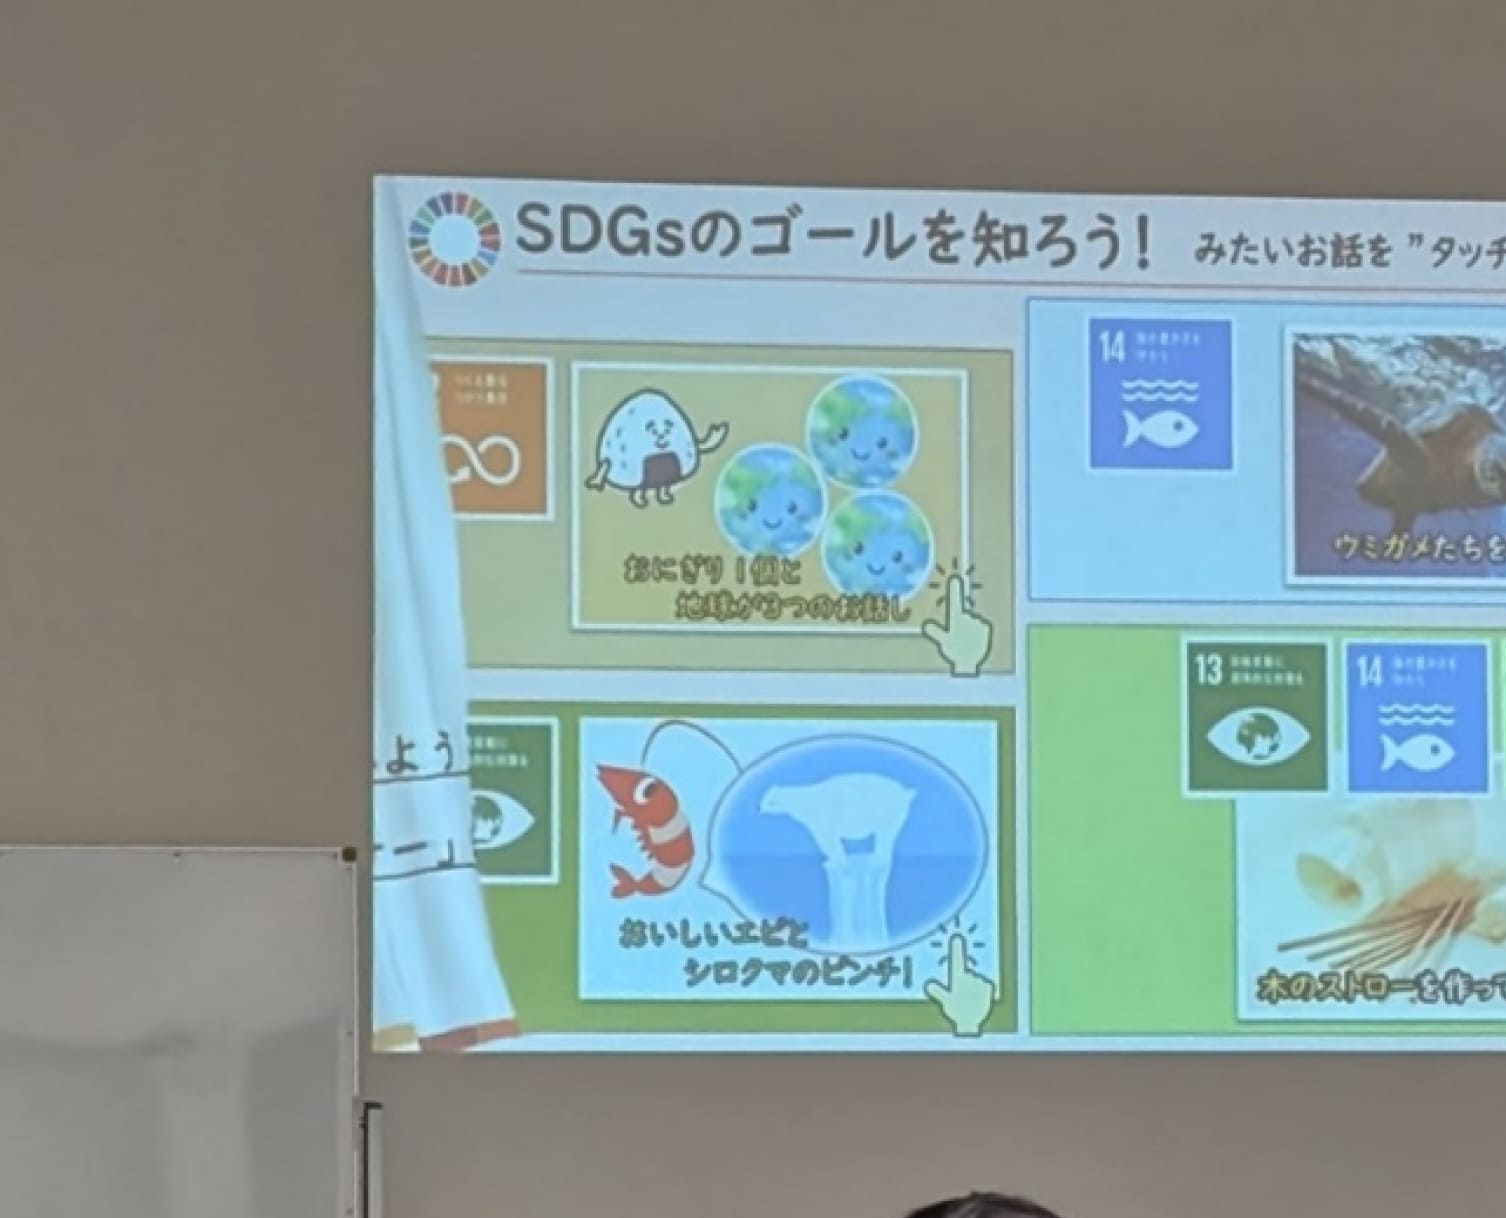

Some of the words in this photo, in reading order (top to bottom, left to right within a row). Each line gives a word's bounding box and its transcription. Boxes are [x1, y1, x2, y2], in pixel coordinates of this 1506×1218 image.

[516, 201, 1149, 270] SDGsのゴールを知ろう!
[1099, 329, 1125, 362] 14
[1195, 653, 1223, 686] 13
[1357, 654, 1383, 687] 14
[619, 917, 809, 949] おいしいエビと
